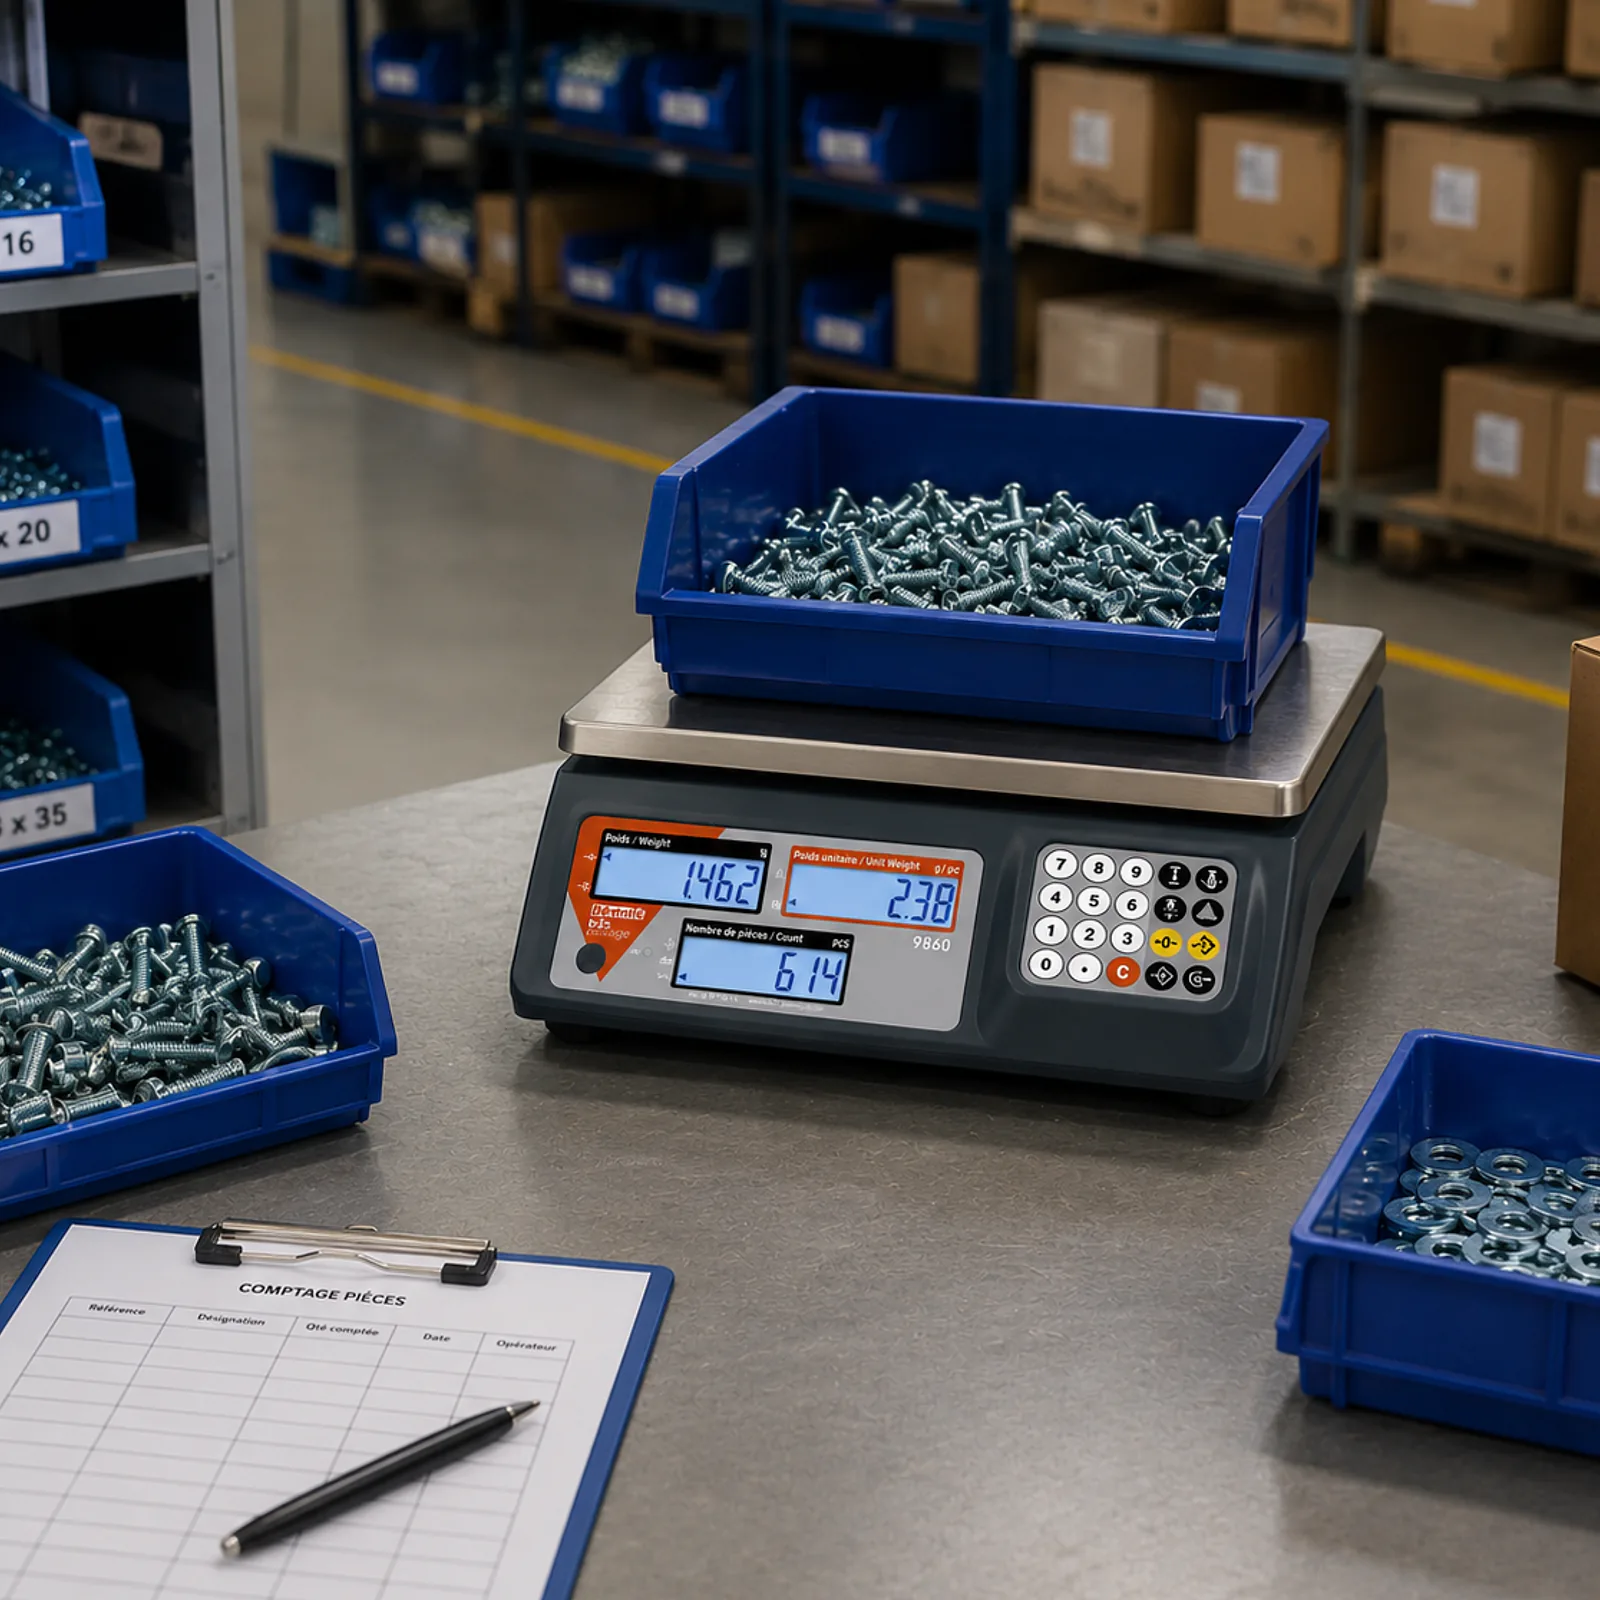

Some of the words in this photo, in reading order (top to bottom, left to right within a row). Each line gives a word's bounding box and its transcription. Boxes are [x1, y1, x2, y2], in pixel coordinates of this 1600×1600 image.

[3, 231, 35, 256] 16
[18, 519, 51, 546] 20
[12, 815, 27, 836] x
[35, 802, 68, 831] 35
[639, 837, 671, 849] Weight
[821, 855, 858, 865] unitaire
[866, 856, 885, 867] Unit
[886, 859, 921, 873] Weight
[1056, 857, 1067, 871] 7
[1093, 861, 1104, 875] 8
[1130, 865, 1142, 879] 9
[887, 878, 956, 924] 2.38
[1050, 890, 1062, 904] 4
[1088, 893, 1100, 907] 5
[1126, 897, 1138, 911] 6
[685, 923, 723, 937] Nombre
[723, 926, 737, 938] de
[775, 932, 804, 944] Count
[1046, 924, 1055, 937] 1
[1083, 927, 1095, 942] 2
[912, 935, 951, 951] 9860
[1121, 931, 1133, 945] 3
[1040, 957, 1051, 971] 0
[774, 951, 843, 995] 614
[1115, 964, 1129, 980] C
[238, 1282, 341, 1301] COMPTAGE
[88, 1303, 147, 1316] Référence
[422, 1332, 452, 1343] Date
[496, 1339, 557, 1352] Opérateur
